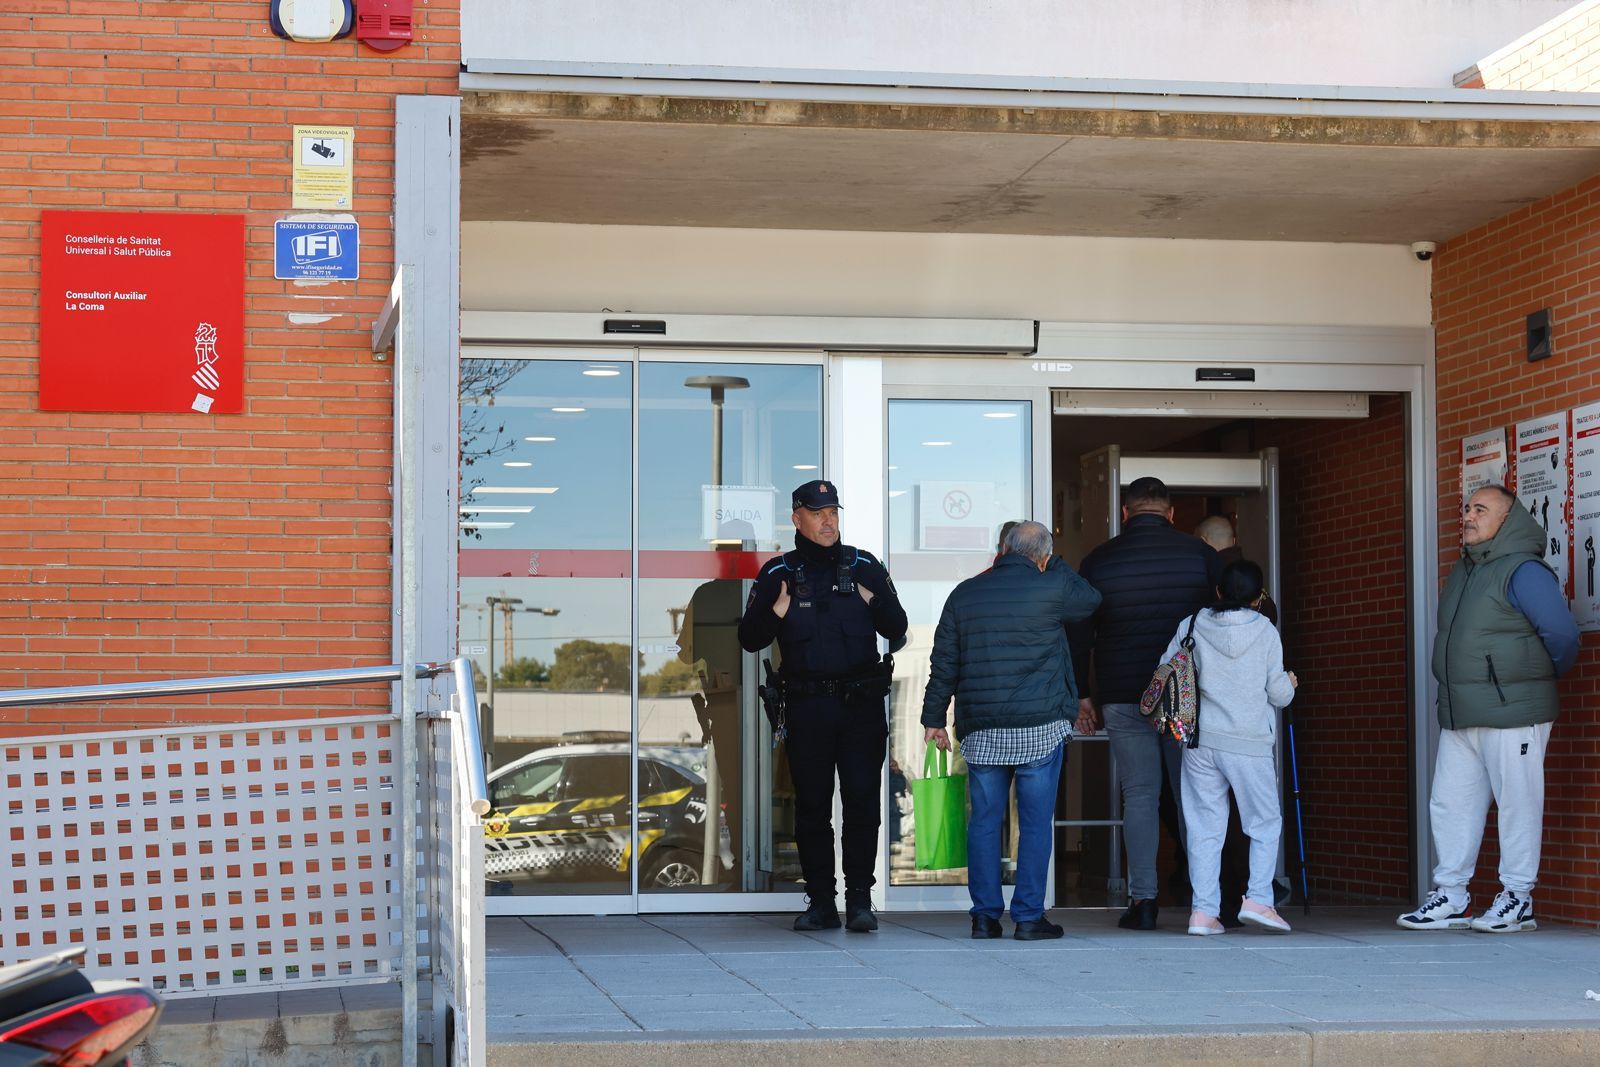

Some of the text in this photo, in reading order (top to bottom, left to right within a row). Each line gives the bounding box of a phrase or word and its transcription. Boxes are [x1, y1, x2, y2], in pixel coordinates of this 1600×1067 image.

[317, 223, 354, 231] SEGURIDAD
[65, 234, 161, 246] Conselleria de Sanitat
[296, 235, 338, 257] IFI
[65, 245, 172, 258] Universal i Salut Pública
[65, 290, 148, 301] Consultori Auxiliar
[65, 301, 105, 312] La Coma
[715, 508, 762, 521] SALIDA
